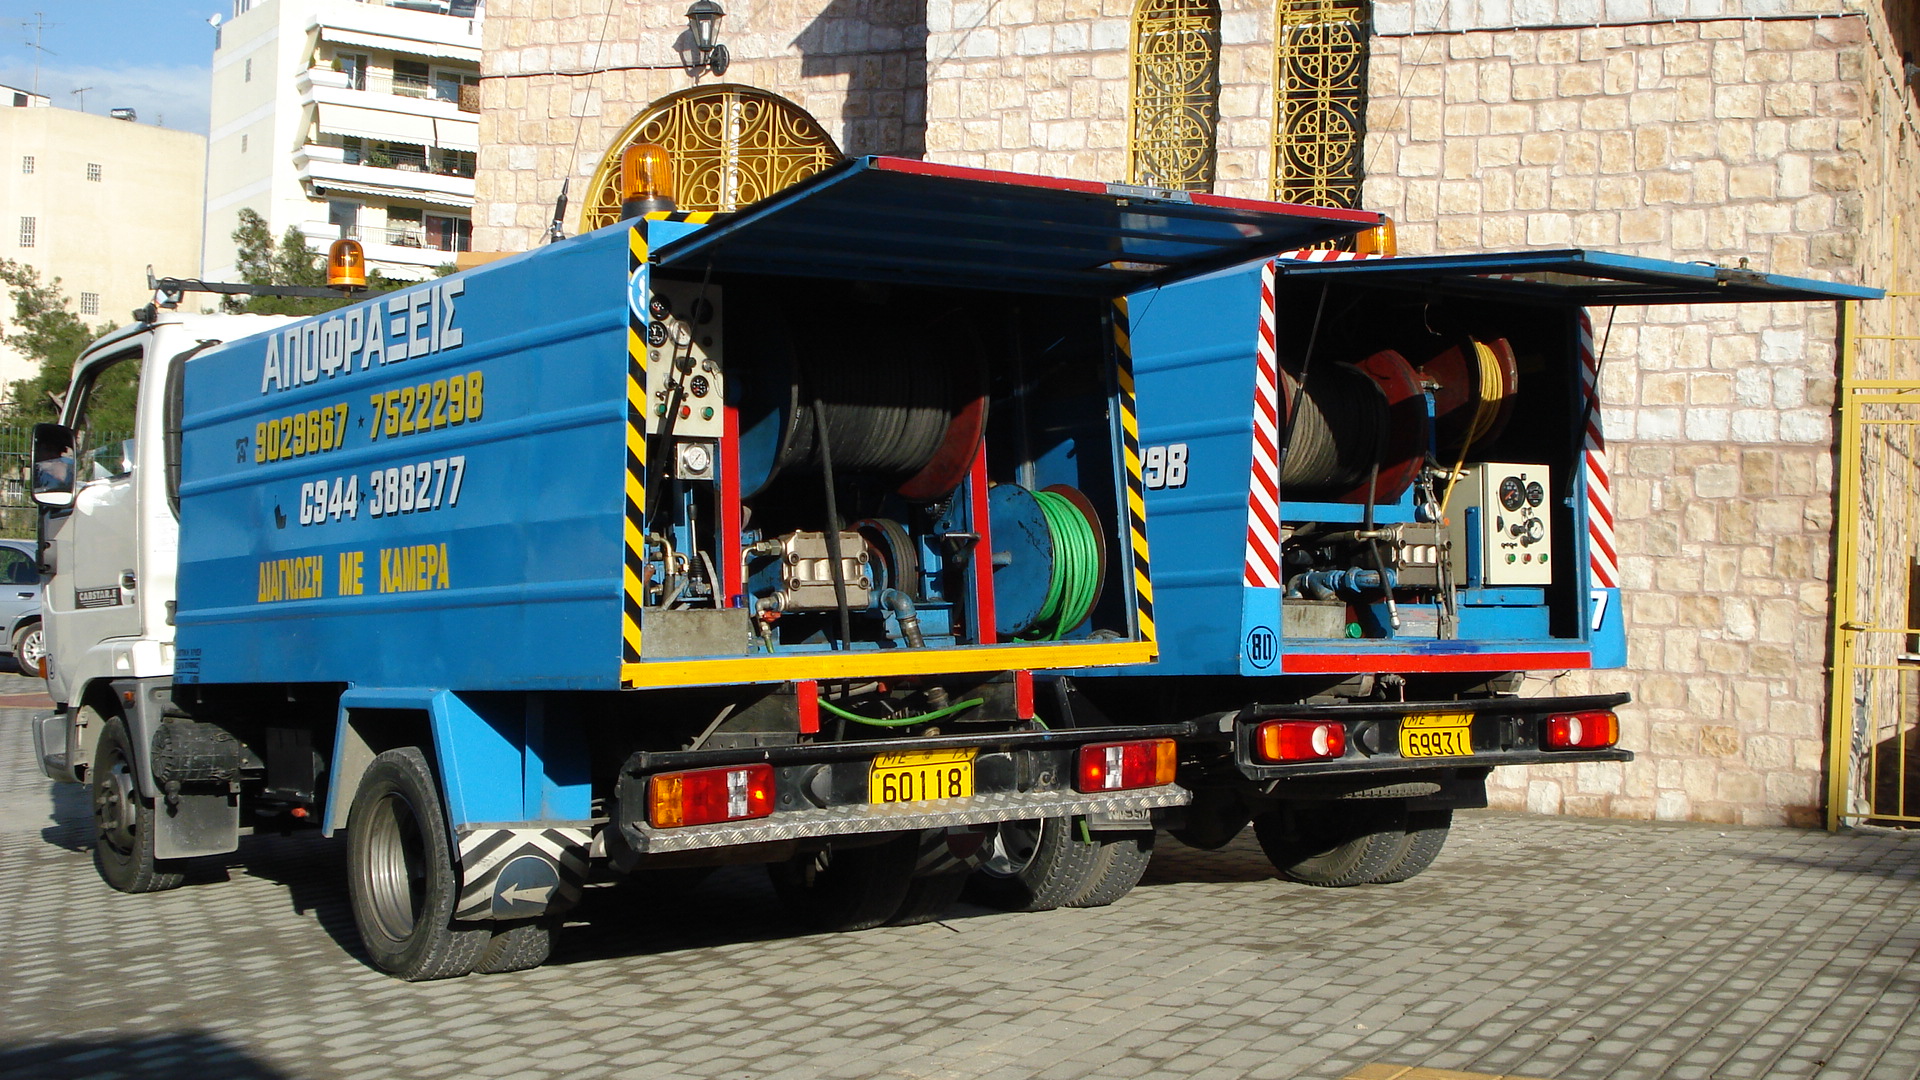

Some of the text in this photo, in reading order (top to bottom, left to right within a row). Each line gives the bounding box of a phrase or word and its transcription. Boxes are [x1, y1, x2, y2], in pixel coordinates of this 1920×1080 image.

[261, 278, 465, 394] ΑΠΟΦΡΑΞΕΙΣ
[255, 371, 483, 464] 9029667 7522298
[370, 456, 465, 516] 388277
[258, 555, 323, 602] ΔΙΑΓΝΩΣΗ
[379, 543, 450, 593] ΚΑΜΕΡΑ
[1252, 633, 1272, 660] 80
[1408, 731, 1466, 756] 69931
[883, 768, 962, 803] 60118
